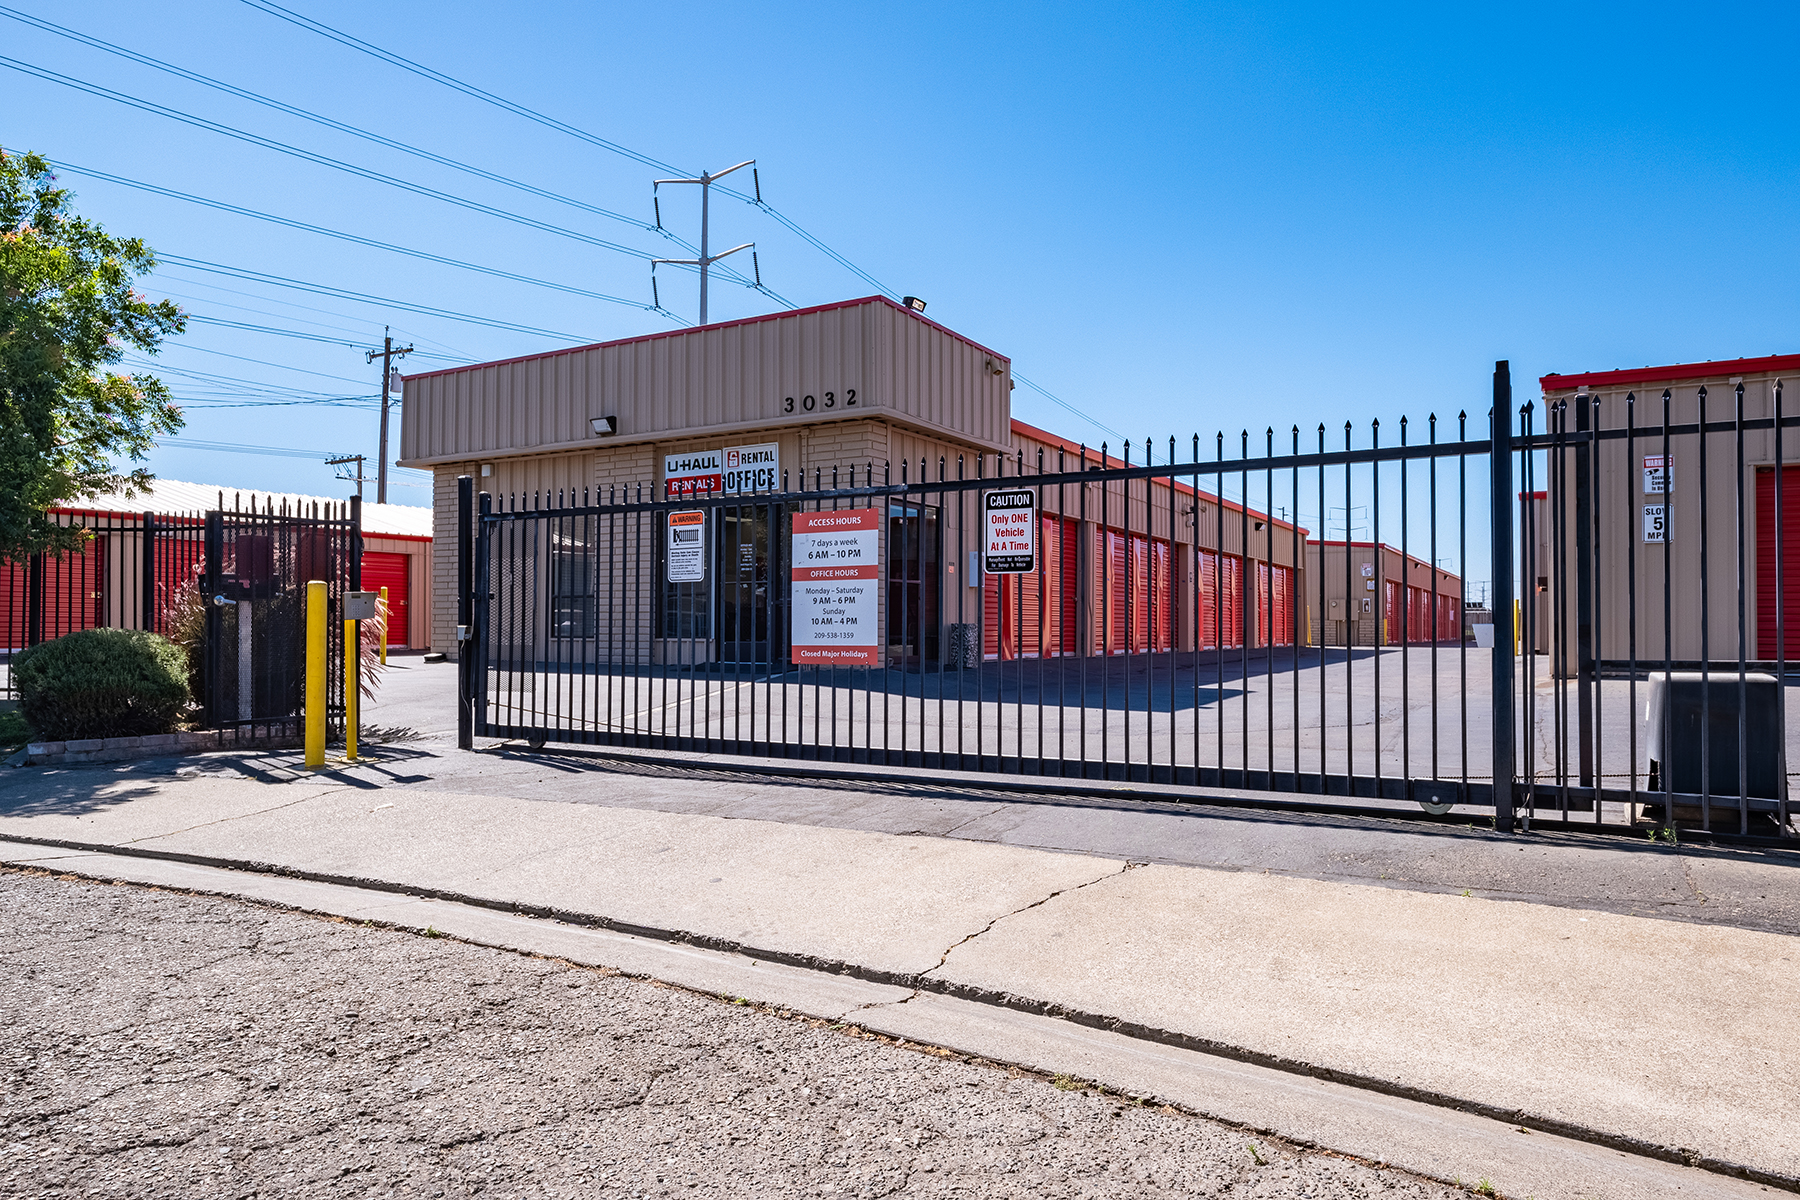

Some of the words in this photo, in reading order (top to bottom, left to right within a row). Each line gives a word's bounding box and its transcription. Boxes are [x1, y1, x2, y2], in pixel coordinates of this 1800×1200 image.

[784, 389, 856, 413] 3032
[741, 450, 775, 465] RENTAL
[667, 456, 719, 472] U-HAUL
[1645, 459, 1672, 467] WARNIG
[671, 478, 715, 492] RENALS
[990, 494, 1030, 507] CAUTION
[808, 518, 835, 527] ACCESS
[836, 517, 861, 525] HOURS
[991, 514, 1009, 525] Only
[1011, 513, 1028, 523] ONE
[1653, 517, 1663, 530] 5
[995, 528, 1025, 537] Vehicle
[817, 539, 833, 548] days
[839, 538, 858, 546] week
[990, 542, 999, 551] At
[1001, 541, 1007, 551] A
[1009, 541, 1029, 550] Time
[808, 551, 813, 559] 6
[815, 551, 829, 559] AM
[837, 550, 846, 558] 10
[848, 549, 861, 558] PM
[835, 569, 859, 577] HOURS
[805, 587, 830, 595] Monday
[836, 587, 864, 595] Saturday
[813, 597, 817, 605] 9
[844, 596, 856, 604] PM
[822, 608, 846, 616] Sunday
[846, 617, 858, 625] PM
[822, 651, 840, 659] Major
[841, 650, 868, 659] Holidays
